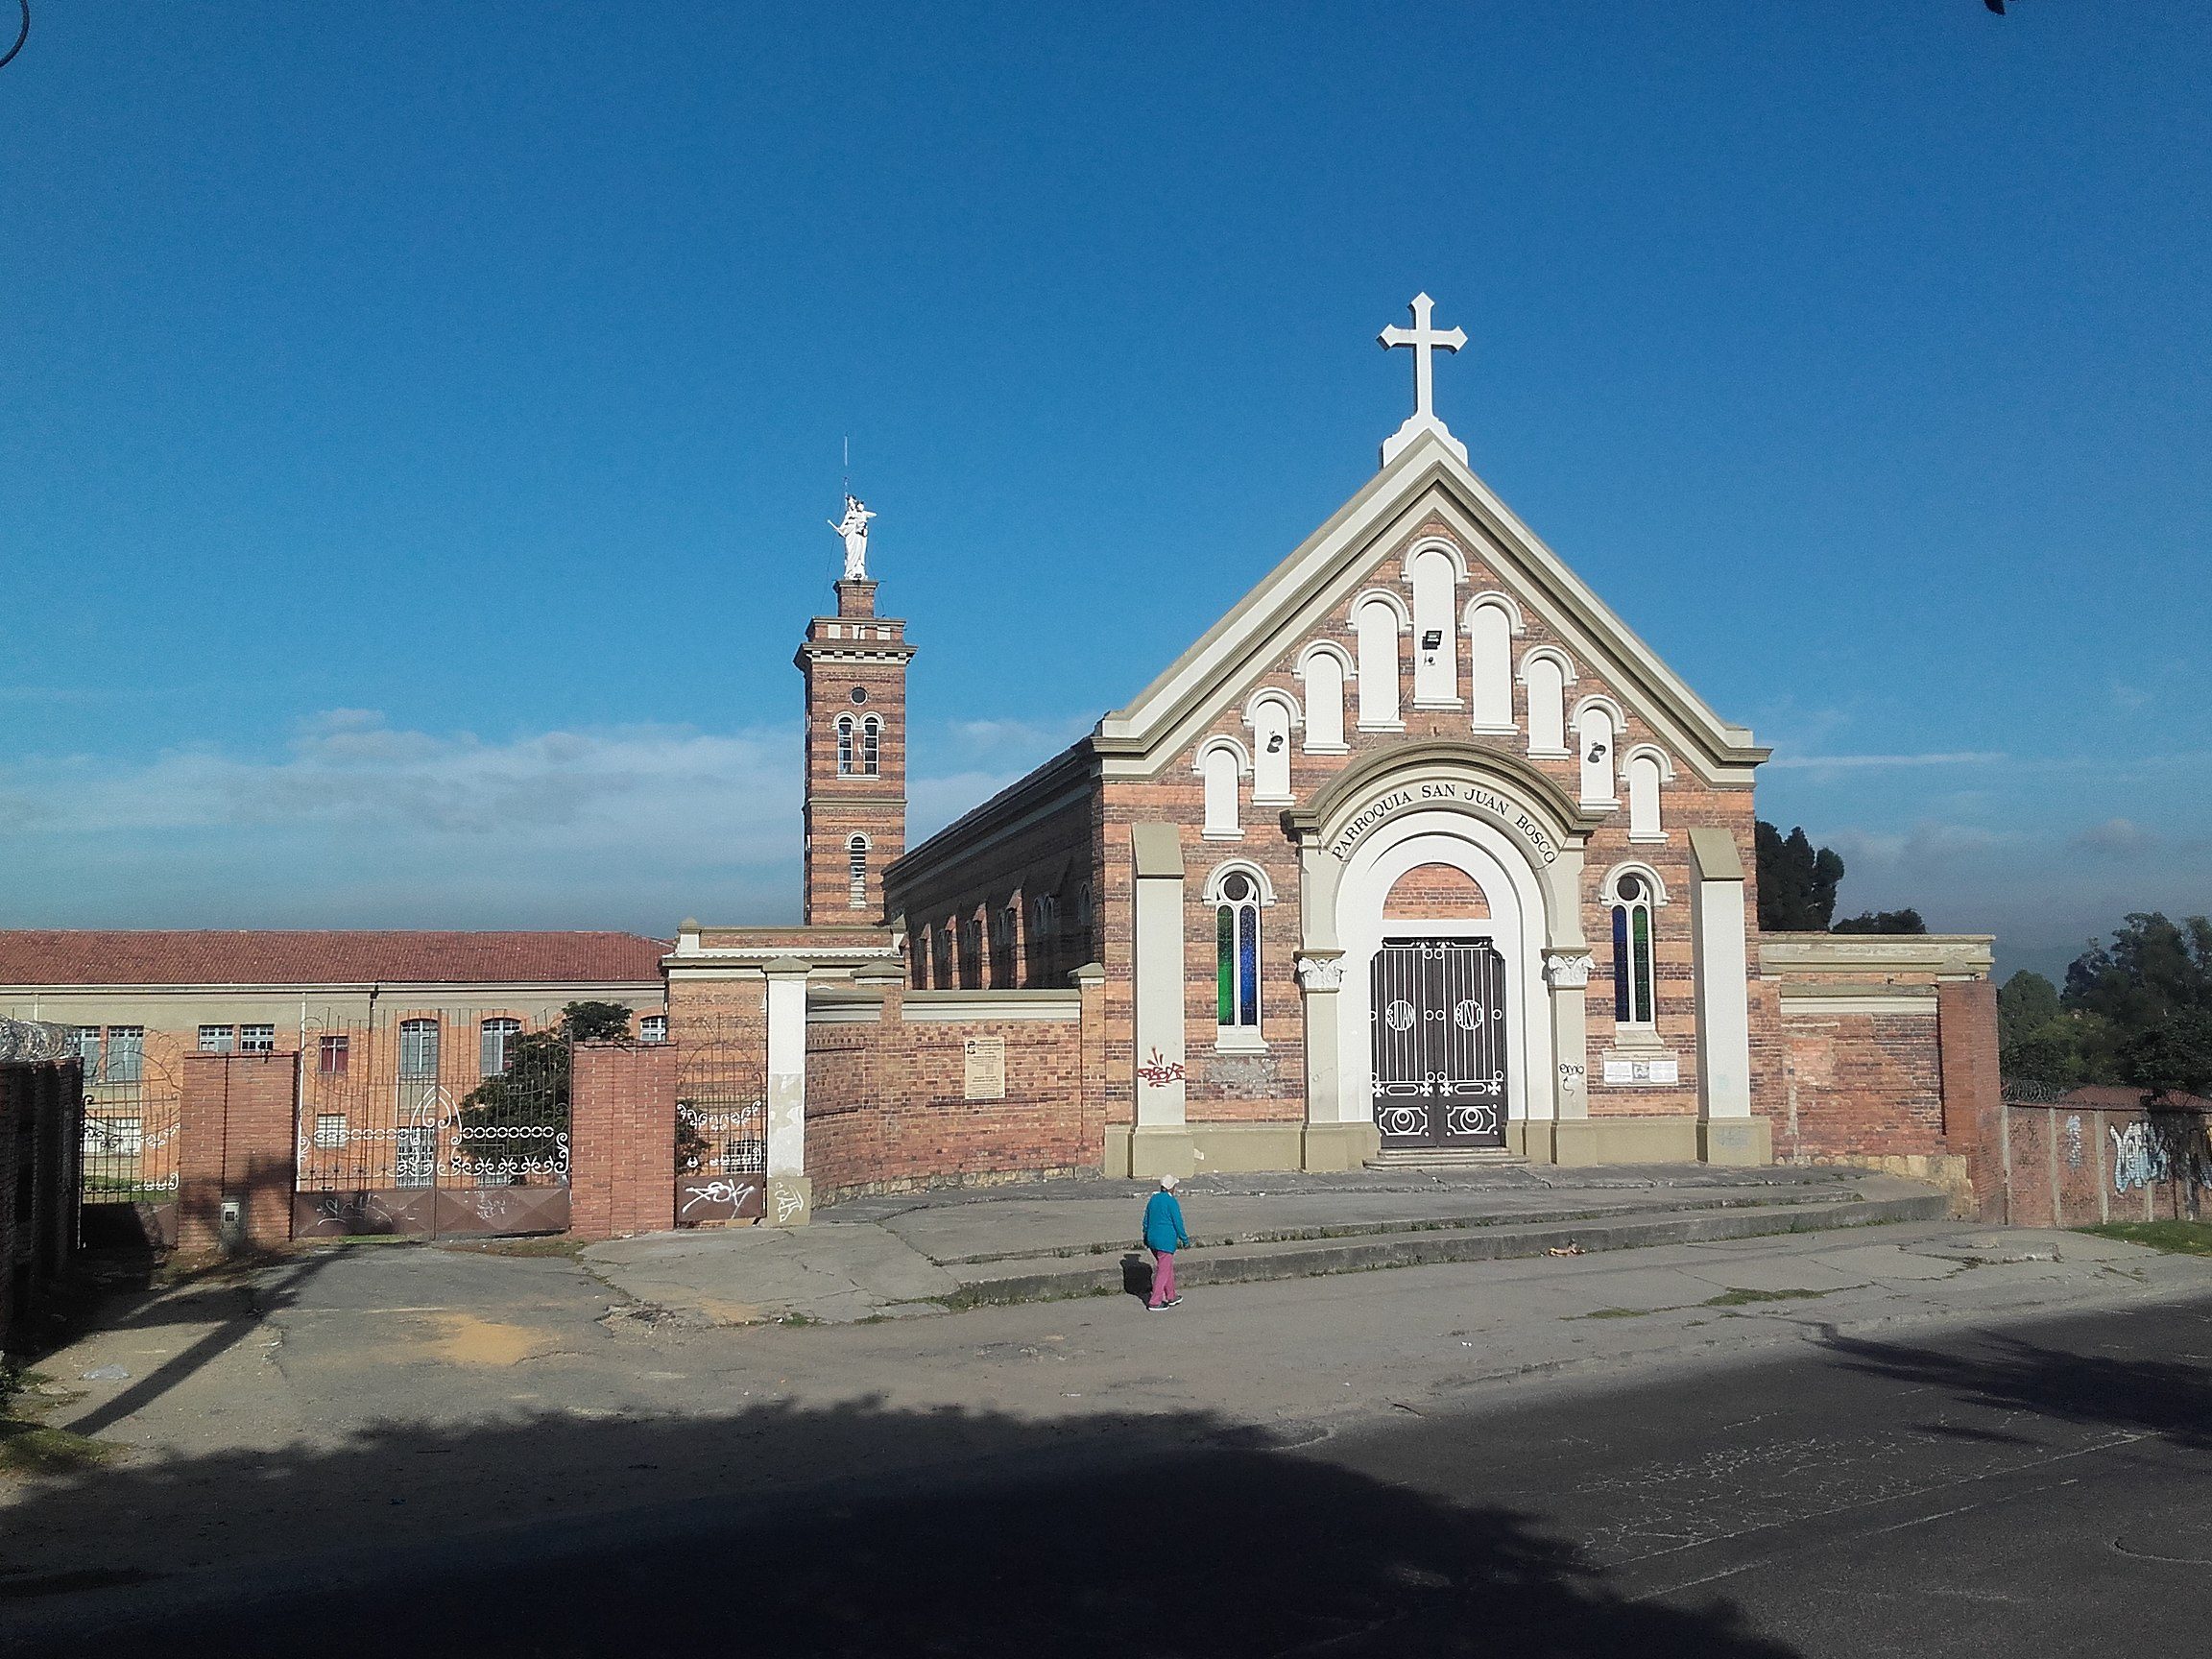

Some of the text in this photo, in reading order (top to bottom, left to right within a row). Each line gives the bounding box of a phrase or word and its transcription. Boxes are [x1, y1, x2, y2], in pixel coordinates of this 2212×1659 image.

[1332, 783, 1555, 863] PARROQUIA SAN JUAN BOSCO
